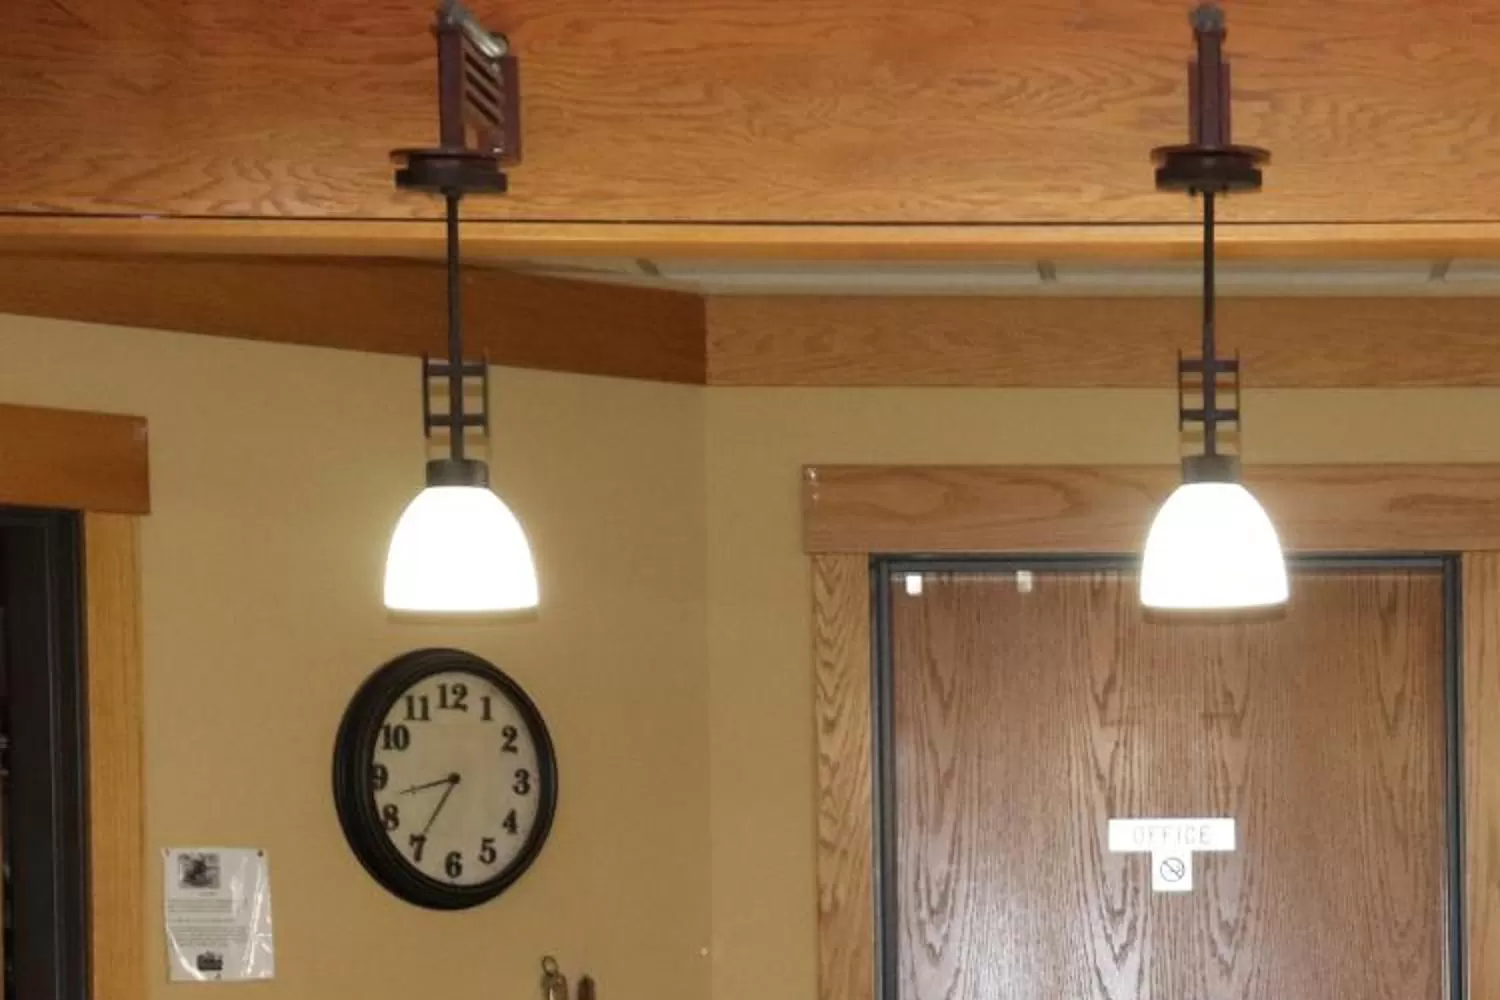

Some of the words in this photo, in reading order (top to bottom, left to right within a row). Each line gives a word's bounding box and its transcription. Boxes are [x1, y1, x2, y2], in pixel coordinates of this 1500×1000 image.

[404, 695, 430, 721] 11
[437, 683, 468, 712] 12
[480, 696, 493, 721] 1
[382, 724, 410, 751] 10
[501, 726, 518, 753] 2
[372, 764, 389, 792] 9
[513, 768, 530, 796] 3
[382, 803, 399, 831] 8
[503, 809, 518, 835] 4
[409, 833, 427, 862] 7
[1132, 824, 1212, 846] OFFICE
[479, 836, 496, 864] 5
[445, 851, 463, 878] 6
